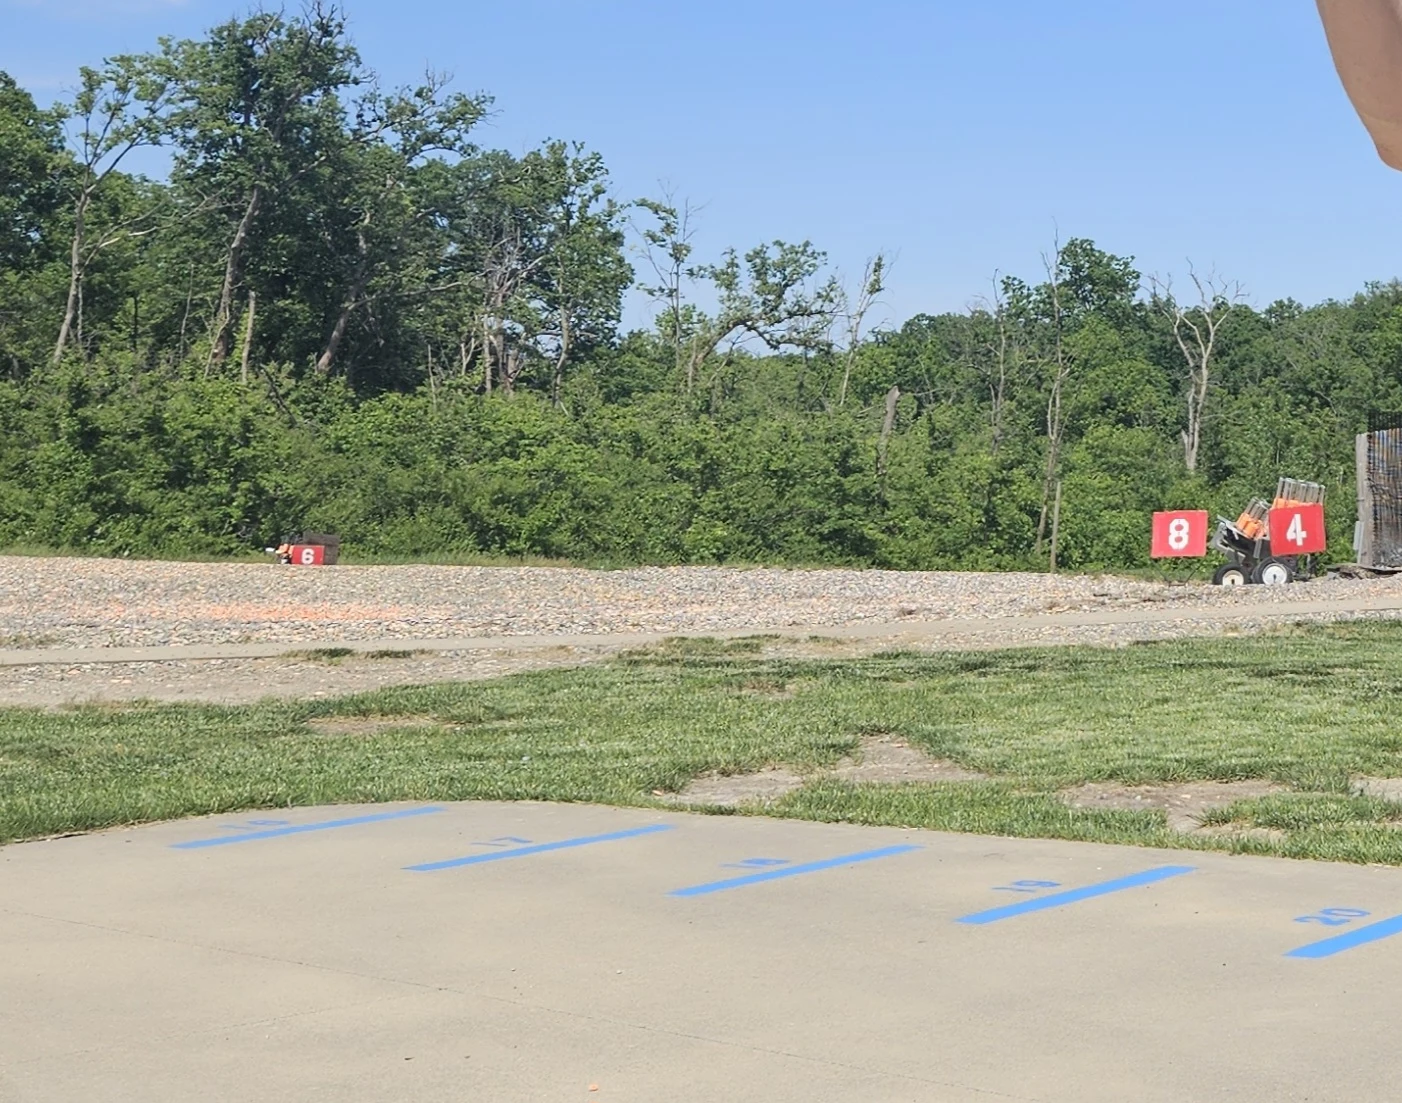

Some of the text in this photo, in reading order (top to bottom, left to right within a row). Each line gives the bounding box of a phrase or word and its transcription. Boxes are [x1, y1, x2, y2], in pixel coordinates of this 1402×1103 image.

[1168, 518, 1190, 550] 8
[1285, 513, 1307, 546] 4
[301, 548, 315, 565] 6
[1293, 908, 1371, 926] 20
